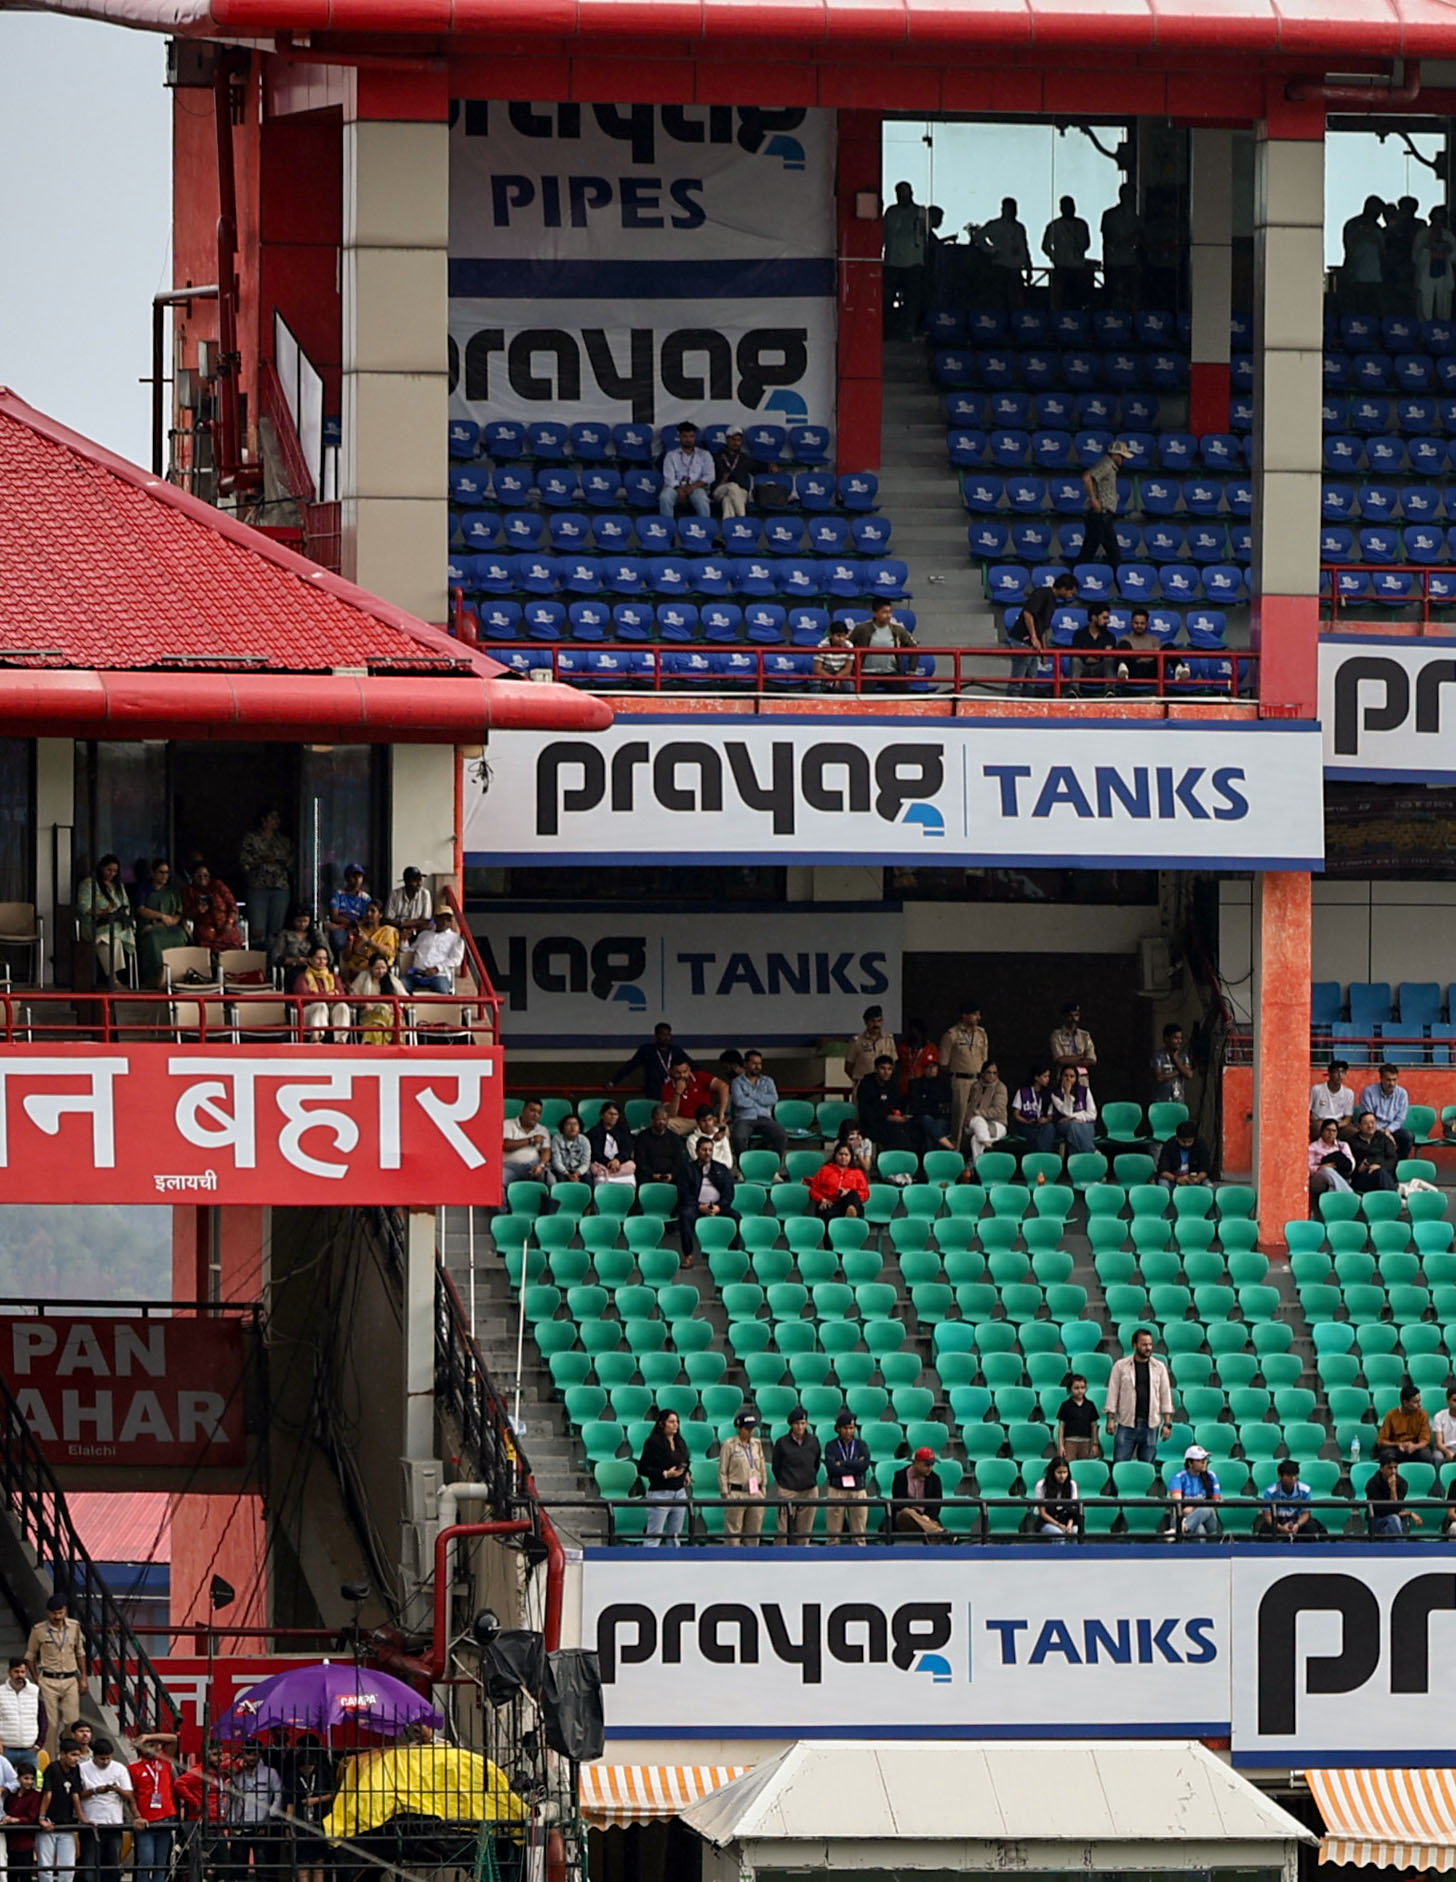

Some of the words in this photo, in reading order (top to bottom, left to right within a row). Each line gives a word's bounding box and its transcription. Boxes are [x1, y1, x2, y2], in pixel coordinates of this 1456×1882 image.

[491, 174, 707, 229] PIPES
[449, 329, 807, 424] rayag
[536, 740, 945, 837] prayag
[983, 765, 1250, 821] TANKS
[678, 952, 888, 995] TANKS
[168, 1057, 493, 1178] बहार
[155, 1169, 217, 1191] इलायची
[12, 1322, 167, 1376] PAN
[68, 1444, 116, 1456] Elaichi
[598, 1602, 952, 1684] prayag
[985, 1617, 1218, 1664] TANKS
